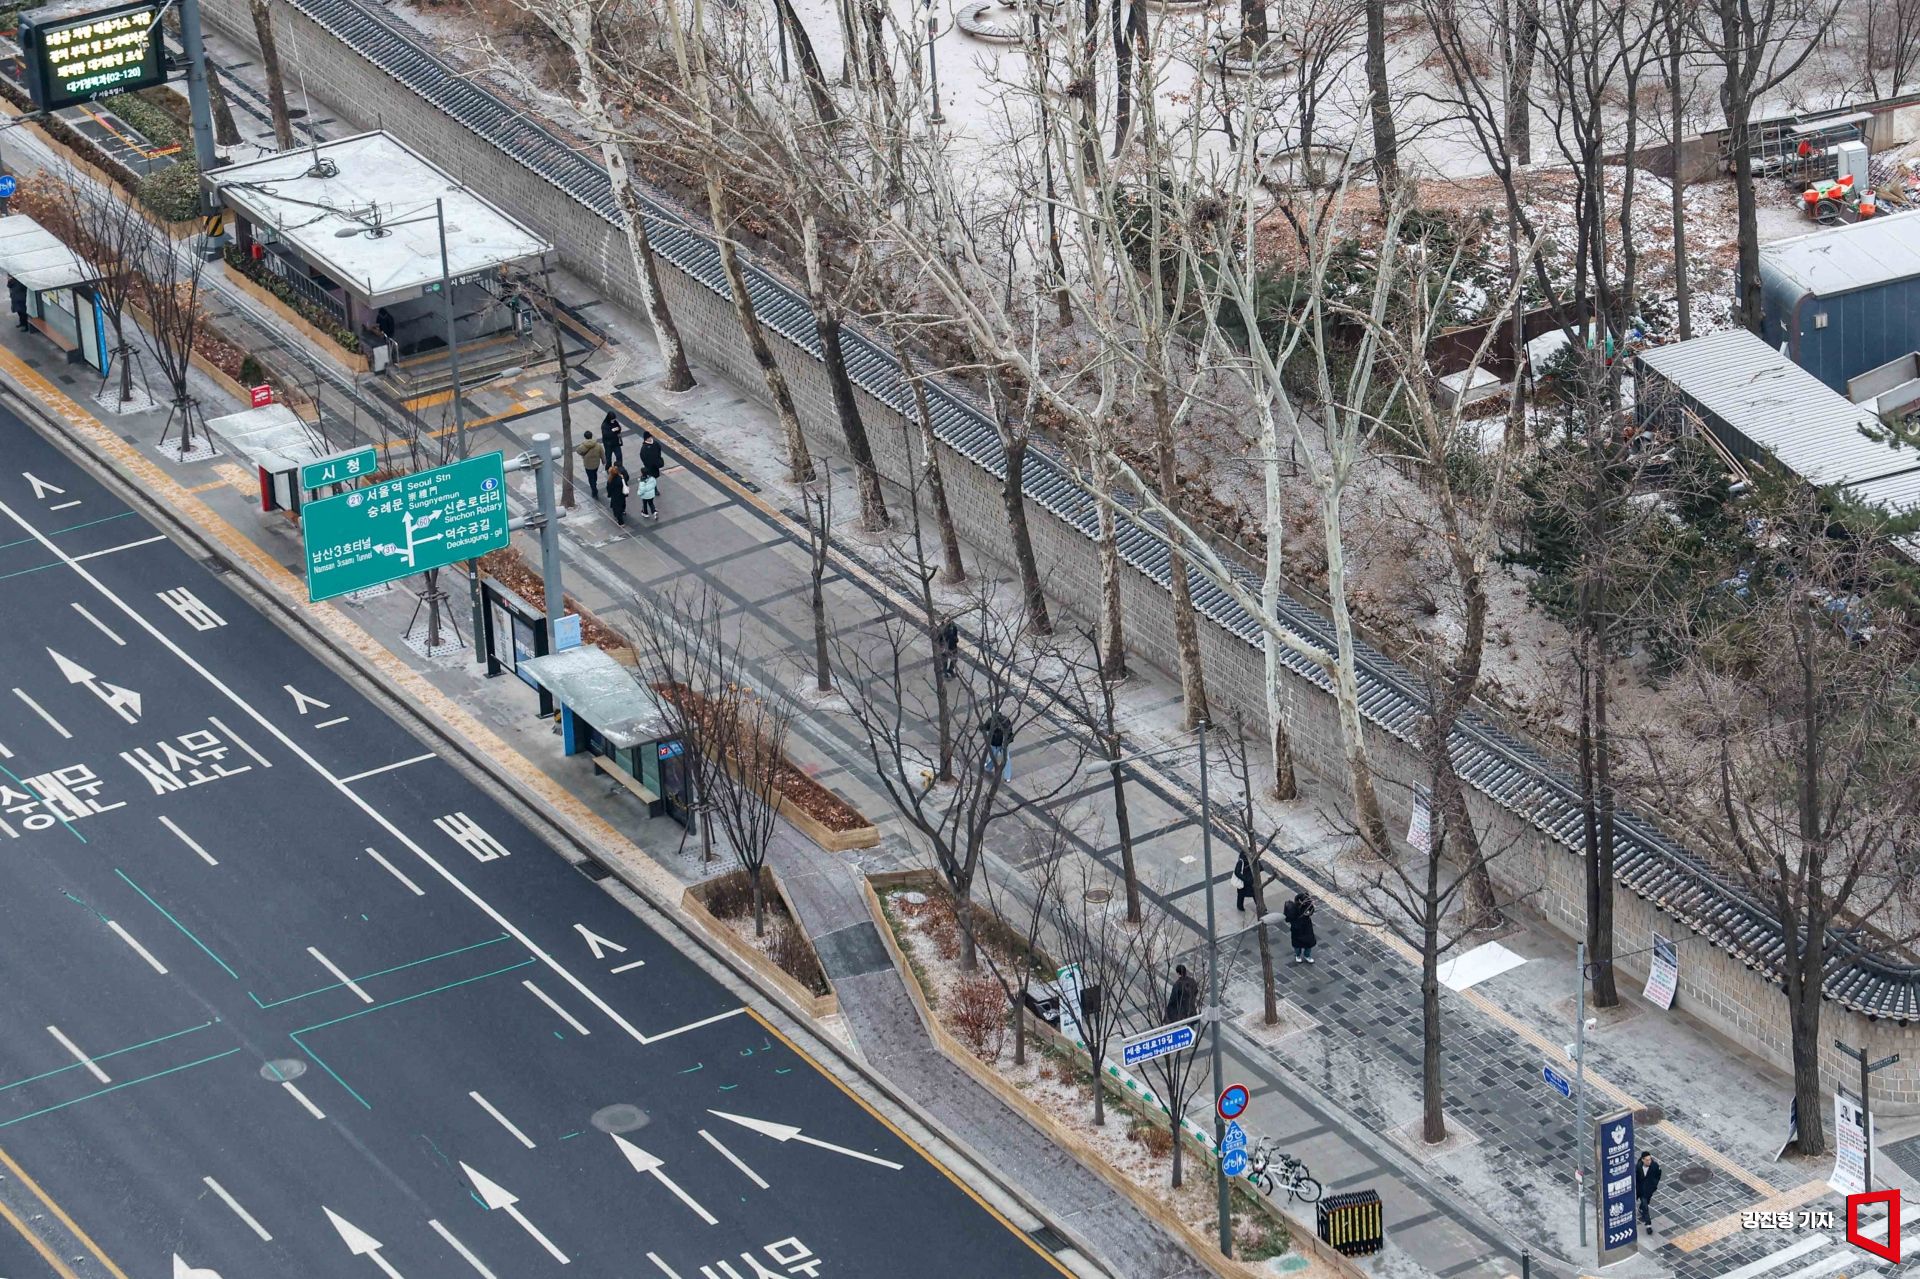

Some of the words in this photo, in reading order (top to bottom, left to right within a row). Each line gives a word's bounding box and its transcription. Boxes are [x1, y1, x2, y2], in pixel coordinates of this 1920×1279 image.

[367, 482, 403, 501] 서울역
[407, 480, 432, 491] Seoul
[435, 474, 450, 484] Stn
[350, 494, 362, 505] 21
[367, 499, 404, 518] 숭례문
[409, 491, 460, 510] Sungnyemun
[444, 490, 501, 515] 신촌로터리
[445, 510, 475, 524] Sinchon
[477, 502, 502, 517] Rotary
[445, 519, 490, 539] 덕수궁길
[312, 537, 372, 564] 남산3호터널
[314, 562, 335, 574] Namsan
[119, 729, 252, 795] 서소문
[0, 763, 127, 830] 숭례문
[1126, 1034, 1173, 1056] 세종대로19길
